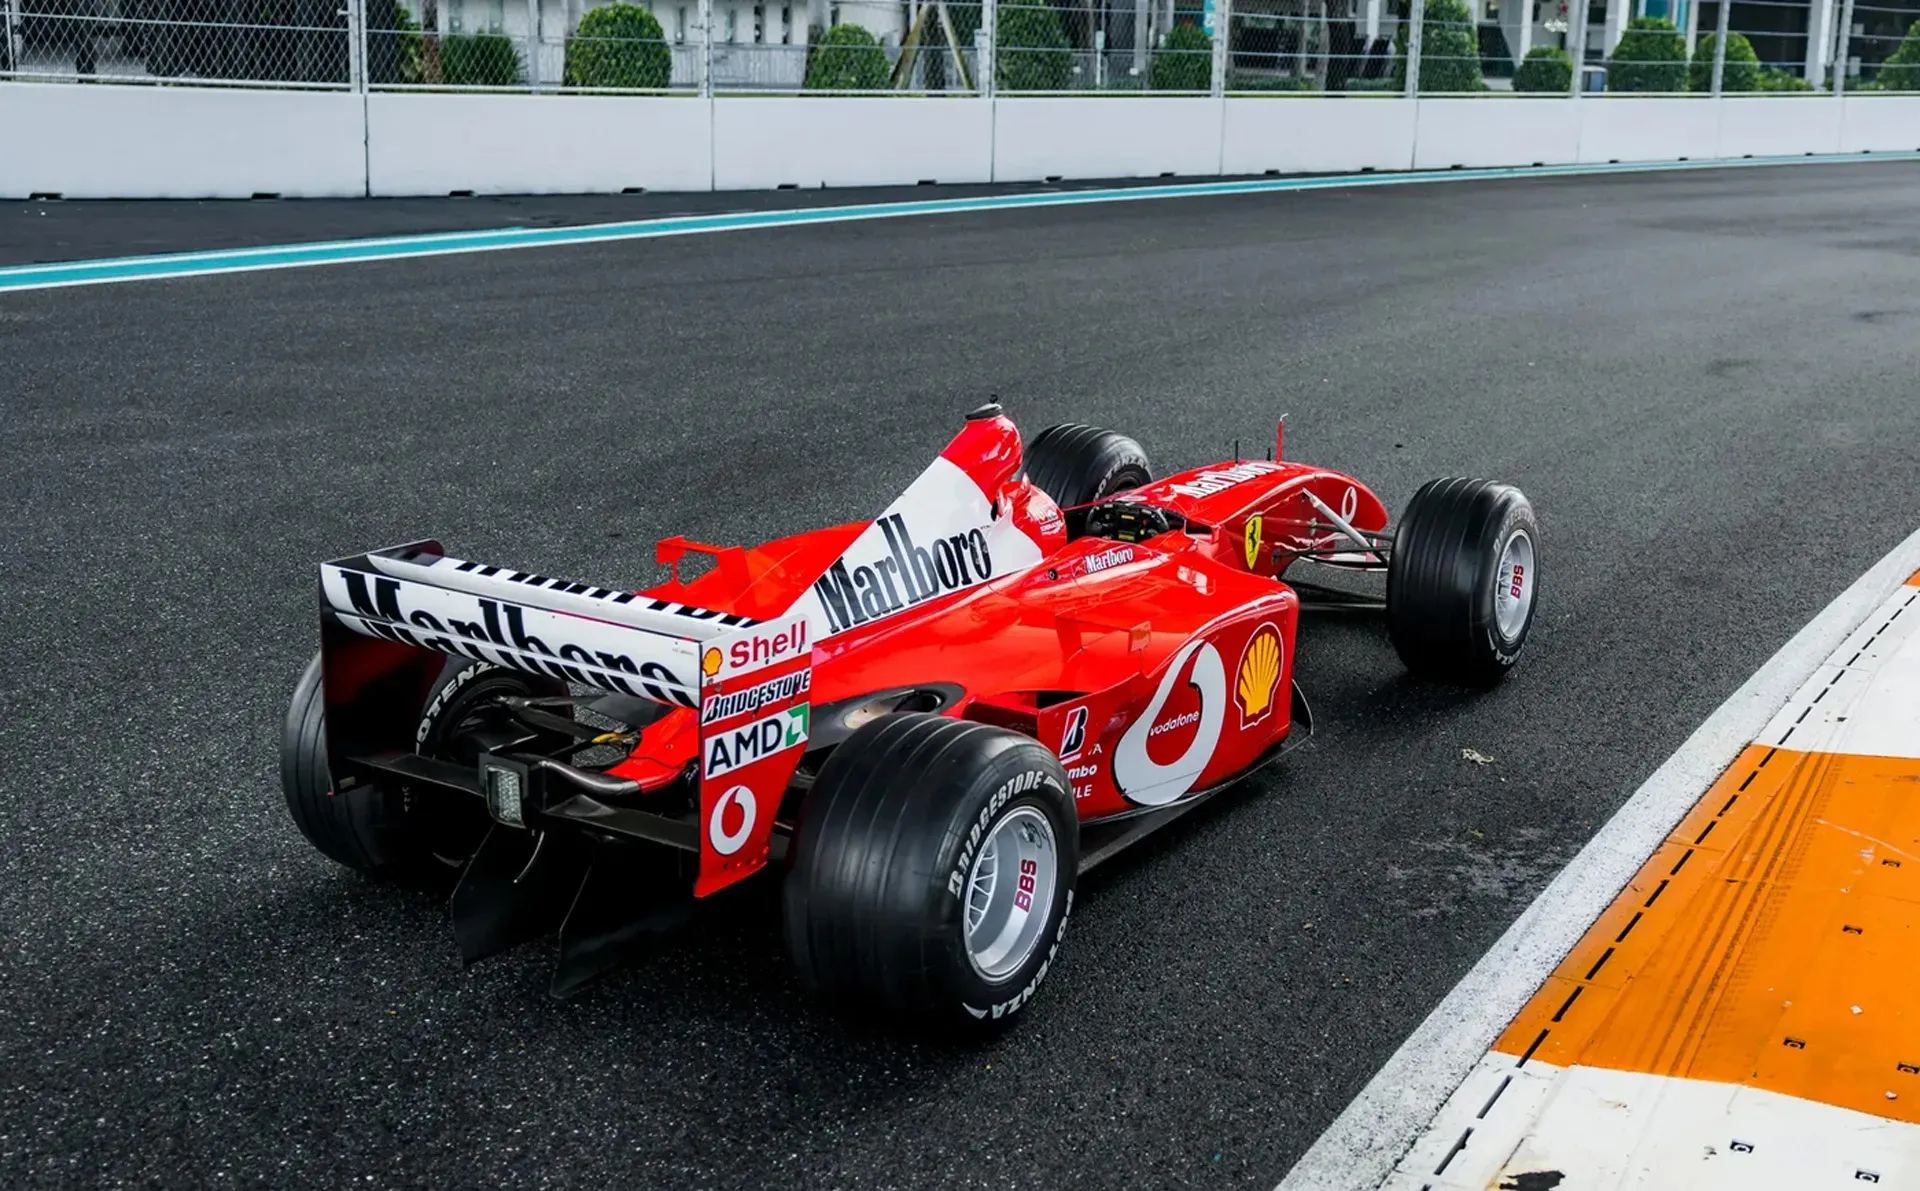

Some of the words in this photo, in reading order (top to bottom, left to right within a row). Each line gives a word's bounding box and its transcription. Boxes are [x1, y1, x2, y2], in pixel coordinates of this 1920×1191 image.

[814, 512, 992, 634] Marlboro
[1085, 548, 1134, 574] Marlboro
[1510, 565, 1524, 599] BBS
[340, 569, 701, 709] Marlboro
[730, 620, 806, 668] Shell
[415, 659, 499, 757] OTENZ
[702, 669, 811, 725] BRIDGESTONE
[1150, 710, 1200, 736] vodafone
[707, 717, 783, 776] AMD
[1067, 764, 1098, 779] mbo
[947, 770, 1044, 900] BRIDGESTONE
[1014, 858, 1038, 913] BBS
